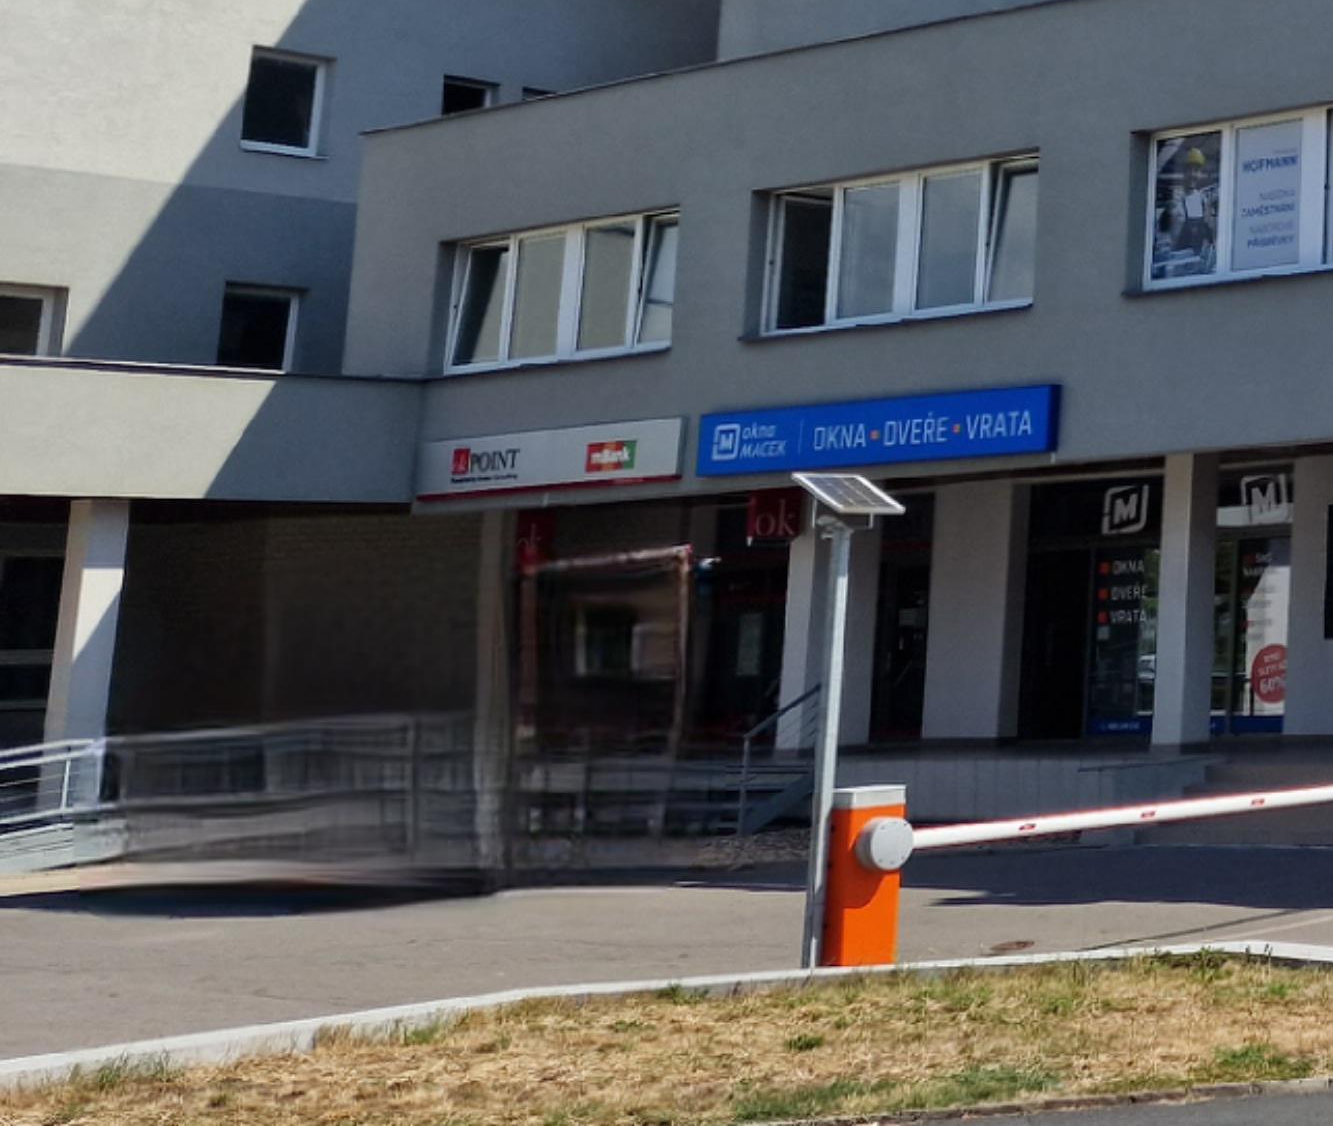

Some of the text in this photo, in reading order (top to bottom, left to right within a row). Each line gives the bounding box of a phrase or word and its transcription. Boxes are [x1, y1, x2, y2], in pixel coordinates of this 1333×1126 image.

[741, 421, 777, 440] okna
[813, 410, 1033, 451] OKNA DVEŘE VRATA
[470, 448, 520, 474] POINT
[755, 498, 798, 537] ok
[1113, 559, 1144, 575] OKNA
[1110, 609, 1147, 625] VRATA
